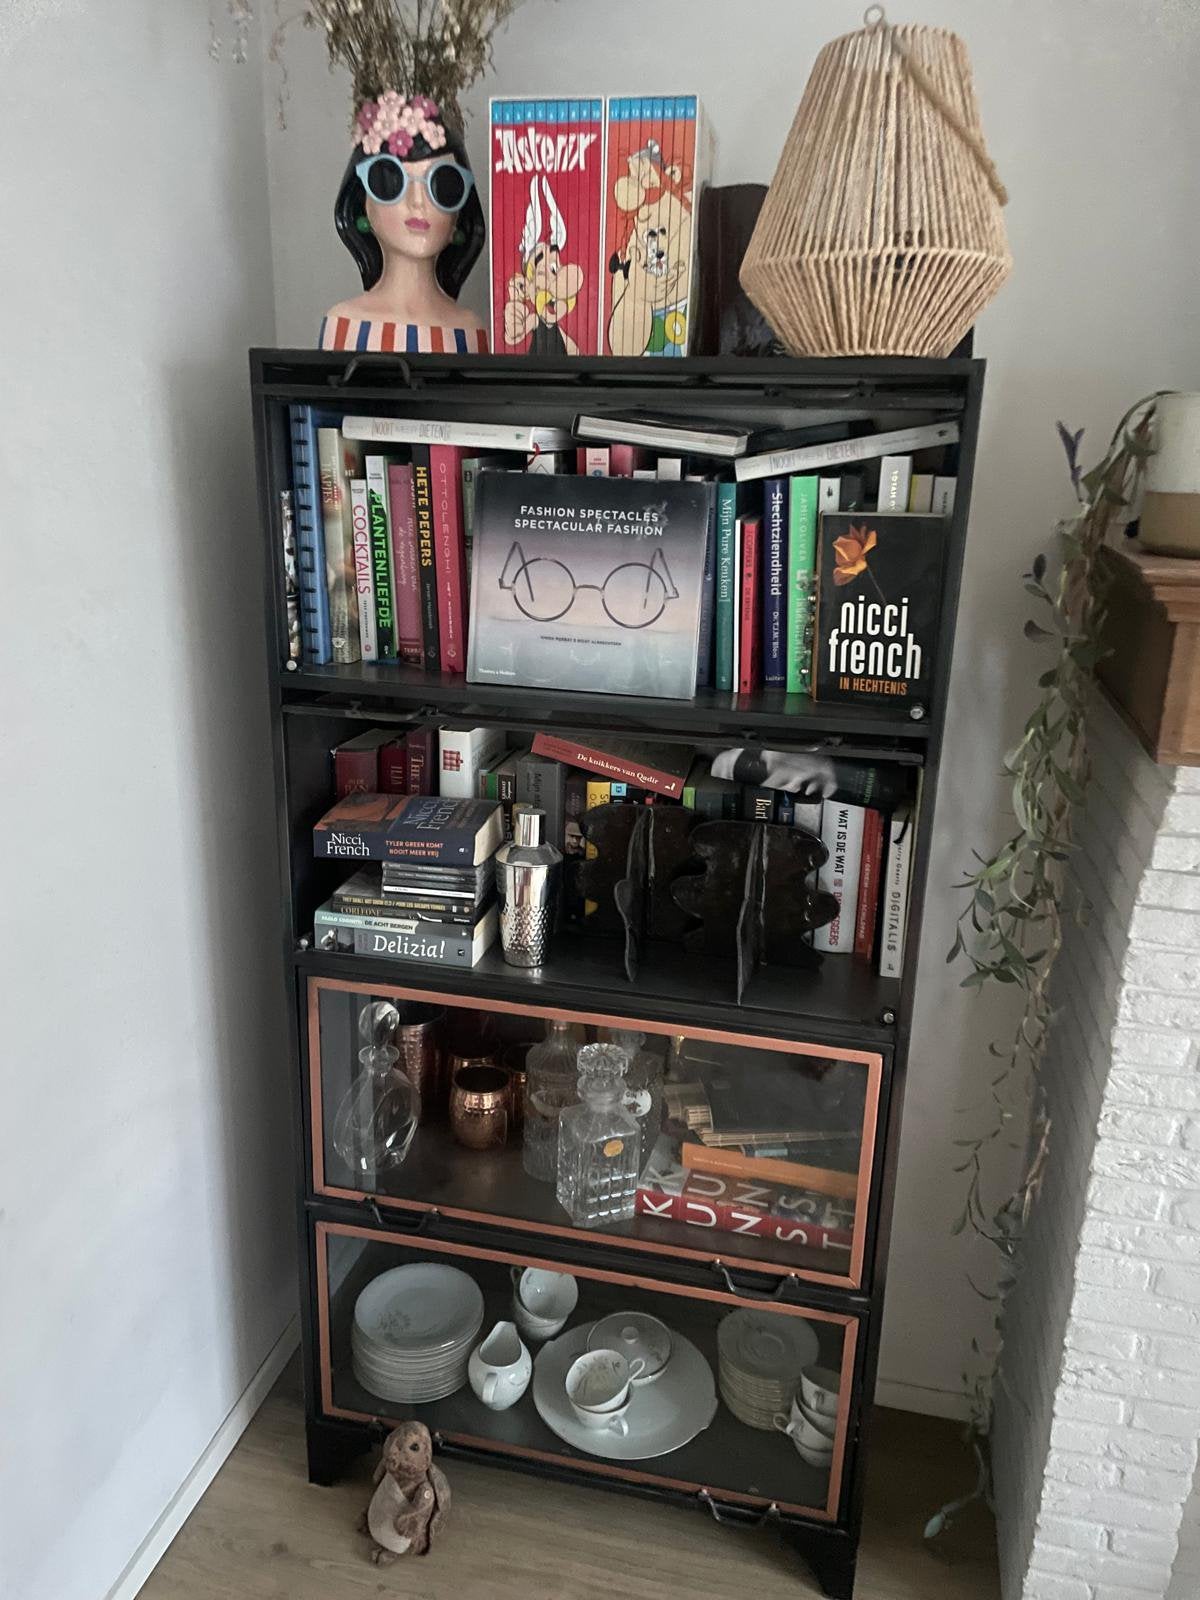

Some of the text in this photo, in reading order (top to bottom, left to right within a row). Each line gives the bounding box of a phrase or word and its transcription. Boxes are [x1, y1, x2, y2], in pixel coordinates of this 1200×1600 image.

[494, 127, 598, 174] Asterix
[416, 466, 432, 567] HETE PEPERS
[440, 463, 451, 573] OTTOLENGHI
[514, 519, 663, 537] SPECTACULAR FASHION
[520, 505, 659, 523] FASHION SPECTACLES
[720, 499, 732, 525] Mijn
[353, 505, 370, 594] COCKTAILS
[721, 529, 732, 554] Pure
[770, 492, 783, 596] Slechtziendheid
[371, 494, 391, 628] PLANTENLIEFDE
[840, 595, 909, 637] nicci
[828, 628, 922, 680] french
[839, 676, 908, 696] IN HECHTENIS
[577, 753, 659, 784] De knikkers van Qadir
[326, 840, 370, 857] French
[331, 832, 362, 846] Nicci
[409, 849, 426, 857] MEER
[834, 809, 848, 875] WAT IS DE WAT
[373, 920, 389, 928] ACHT
[390, 922, 414, 931] BERGEN
[887, 891, 902, 952] DIGITALIS
[372, 934, 446, 959] Delizia!
[642, 1194, 851, 1250] KUNST
